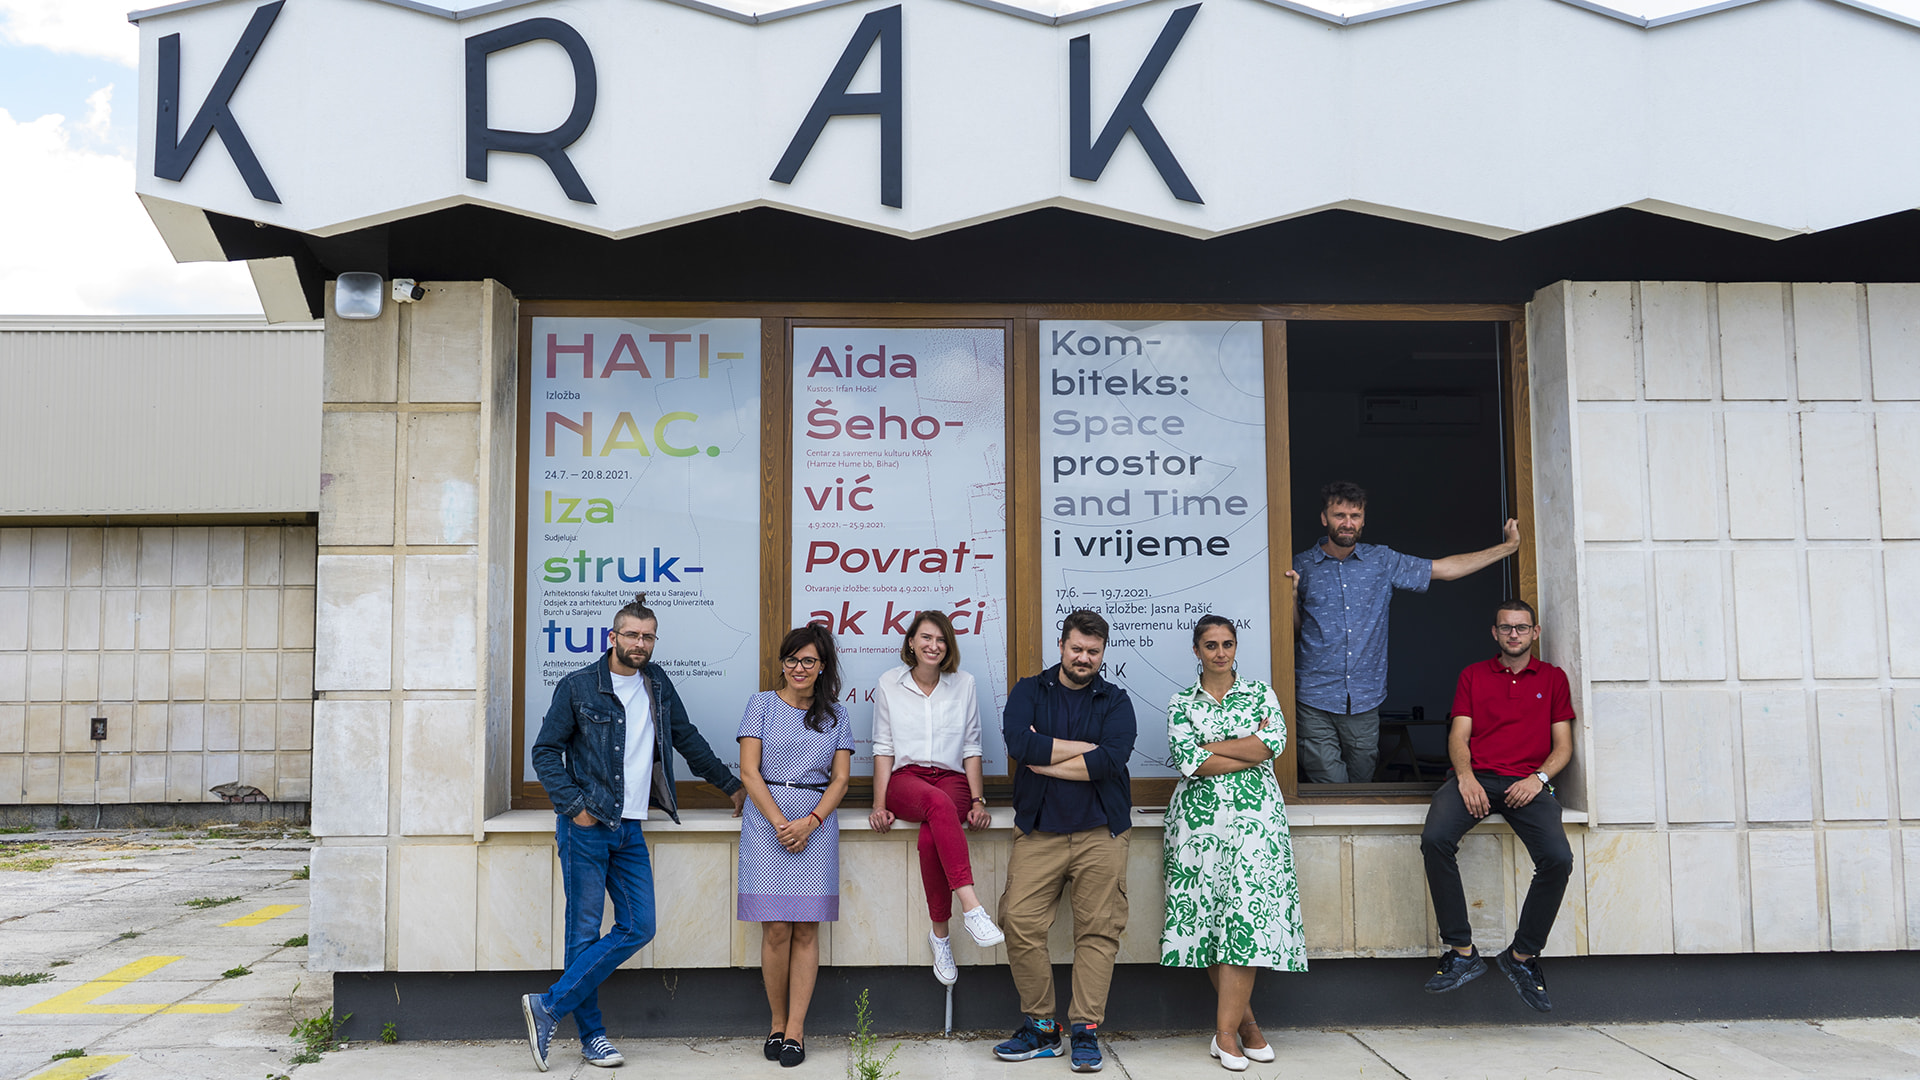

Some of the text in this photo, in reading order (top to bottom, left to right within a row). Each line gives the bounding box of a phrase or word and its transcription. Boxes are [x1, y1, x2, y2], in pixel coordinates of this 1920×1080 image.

[154, 0, 1204, 208] KRAK
[1052, 330, 1161, 356] Kom-
[546, 333, 744, 378] HATI-
[807, 344, 917, 378] Aida
[1052, 368, 1189, 395] biteks:
[807, 384, 877, 393] Kustos: Irfan Hošić
[546, 391, 580, 400] Izložba
[806, 399, 963, 440] Šeho-
[1053, 409, 1185, 443] Space
[546, 411, 720, 457] NAC.
[807, 449, 830, 457] Centar
[884, 449, 910, 457] kulturu
[912, 449, 932, 457] KRAK
[807, 460, 836, 469] (Hamze
[838, 460, 861, 468] Hume
[863, 460, 875, 470] bb,
[1054, 450, 1203, 483] prostor
[545, 470, 568, 479] 24.7.
[581, 470, 632, 479] 20.8.2021.
[804, 474, 874, 511] vić
[544, 491, 614, 523] Iza
[1054, 489, 1248, 516] and Time
[544, 534, 578, 543] Sudjeluju:
[1054, 529, 1230, 564] i vrijeme
[805, 541, 994, 573] Povrat-
[543, 547, 704, 583] struk-
[544, 590, 589, 598] Arhitektonski
[591, 590, 617, 598] fakultet
[668, 590, 698, 600] Sarajevu
[805, 585, 841, 593] Otvaranje
[843, 584, 871, 592] izložbe:
[899, 585, 932, 593] 4.9.2021.
[1056, 587, 1079, 598] 17.6.
[1101, 588, 1152, 599] 19.7.2021.
[544, 600, 567, 609] Odsjek
[673, 599, 714, 607] Univerziteta
[1106, 603, 1147, 614] izložbe:
[1151, 604, 1179, 616] Jasna
[1185, 603, 1212, 613] Pašić
[544, 609, 564, 617] Burch
[572, 609, 601, 618] Sarajevu
[805, 597, 987, 635] ak kći
[1113, 622, 1173, 631] savremenu
[1141, 637, 1154, 648] bb
[836, 646, 858, 654] Kuma
[674, 659, 700, 667] fakultet
[693, 669, 722, 680] Sarajevu
